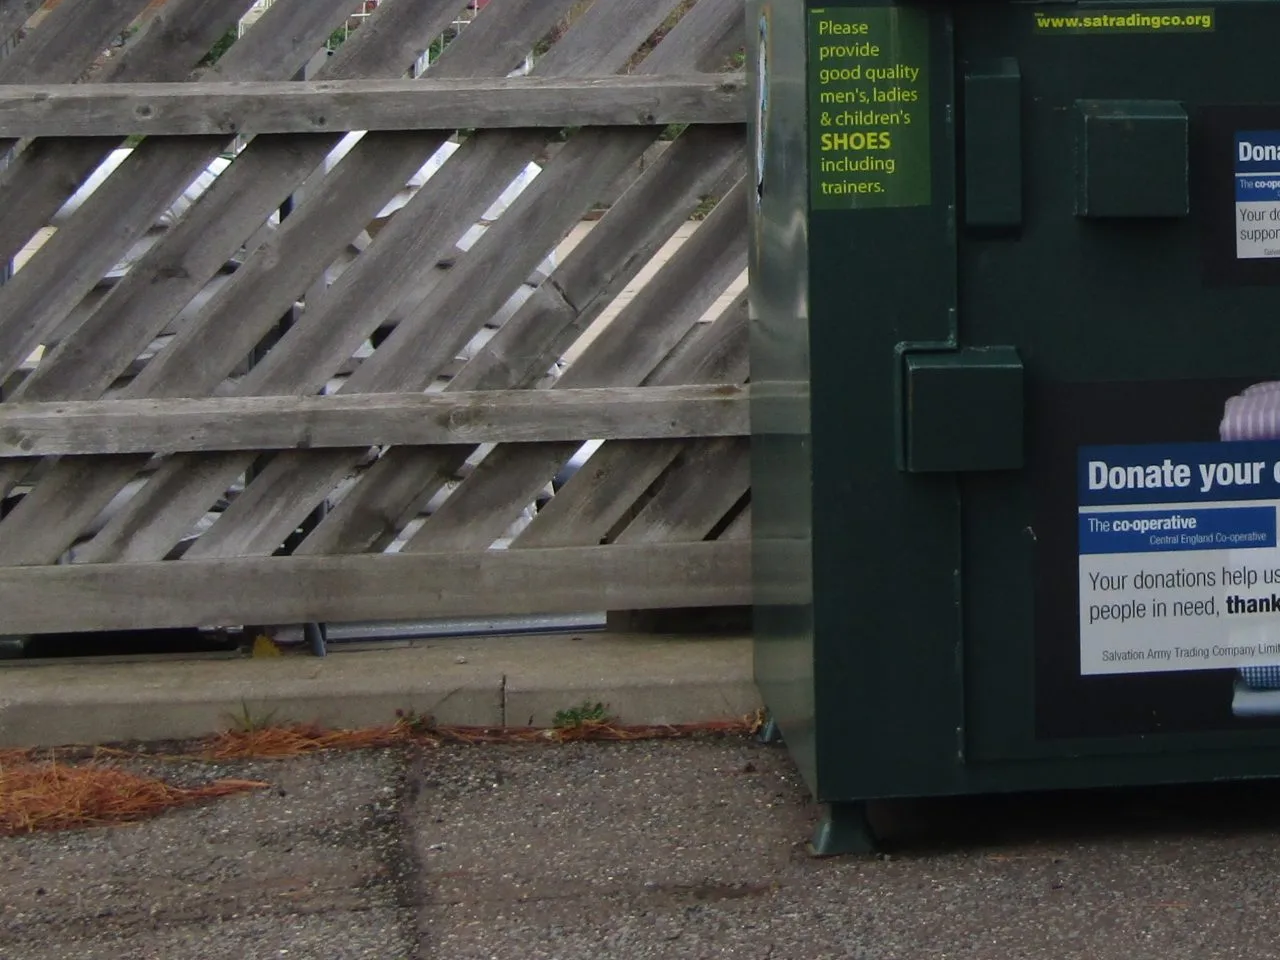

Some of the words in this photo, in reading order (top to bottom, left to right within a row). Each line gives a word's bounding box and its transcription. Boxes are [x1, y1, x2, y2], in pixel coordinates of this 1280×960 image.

[819, 21, 869, 35] Please
[1037, 13, 1211, 29] www.satradingco.org
[820, 42, 880, 61] provide
[820, 65, 860, 84] good
[865, 65, 919, 82] quality
[820, 89, 869, 104] men's,
[873, 88, 918, 102] ladies
[820, 112, 832, 126] &
[835, 110, 911, 126] children's
[821, 132, 891, 151] SHOES
[821, 156, 895, 174] including
[821, 180, 885, 194] trainers.
[1240, 179, 1253, 188] The
[1240, 208, 1266, 221] Your
[1089, 459, 1190, 489] Donate
[1199, 461, 1265, 492] your
[1088, 518, 1110, 532] The
[1113, 515, 1196, 533] co-operative
[1150, 535, 1178, 545] Central
[1181, 534, 1213, 545] England
[1216, 532, 1266, 543] Co-operative
[1089, 572, 1128, 591] Your
[1134, 568, 1215, 589] donations
[1223, 566, 1257, 587] help
[1089, 599, 1146, 624] people
[1153, 598, 1167, 617] in
[1174, 596, 1220, 617] need,
[1102, 650, 1144, 662] Salvation
[1147, 648, 1171, 660] Army
[1175, 647, 1209, 660] Trading
[1212, 645, 1255, 658] Company
